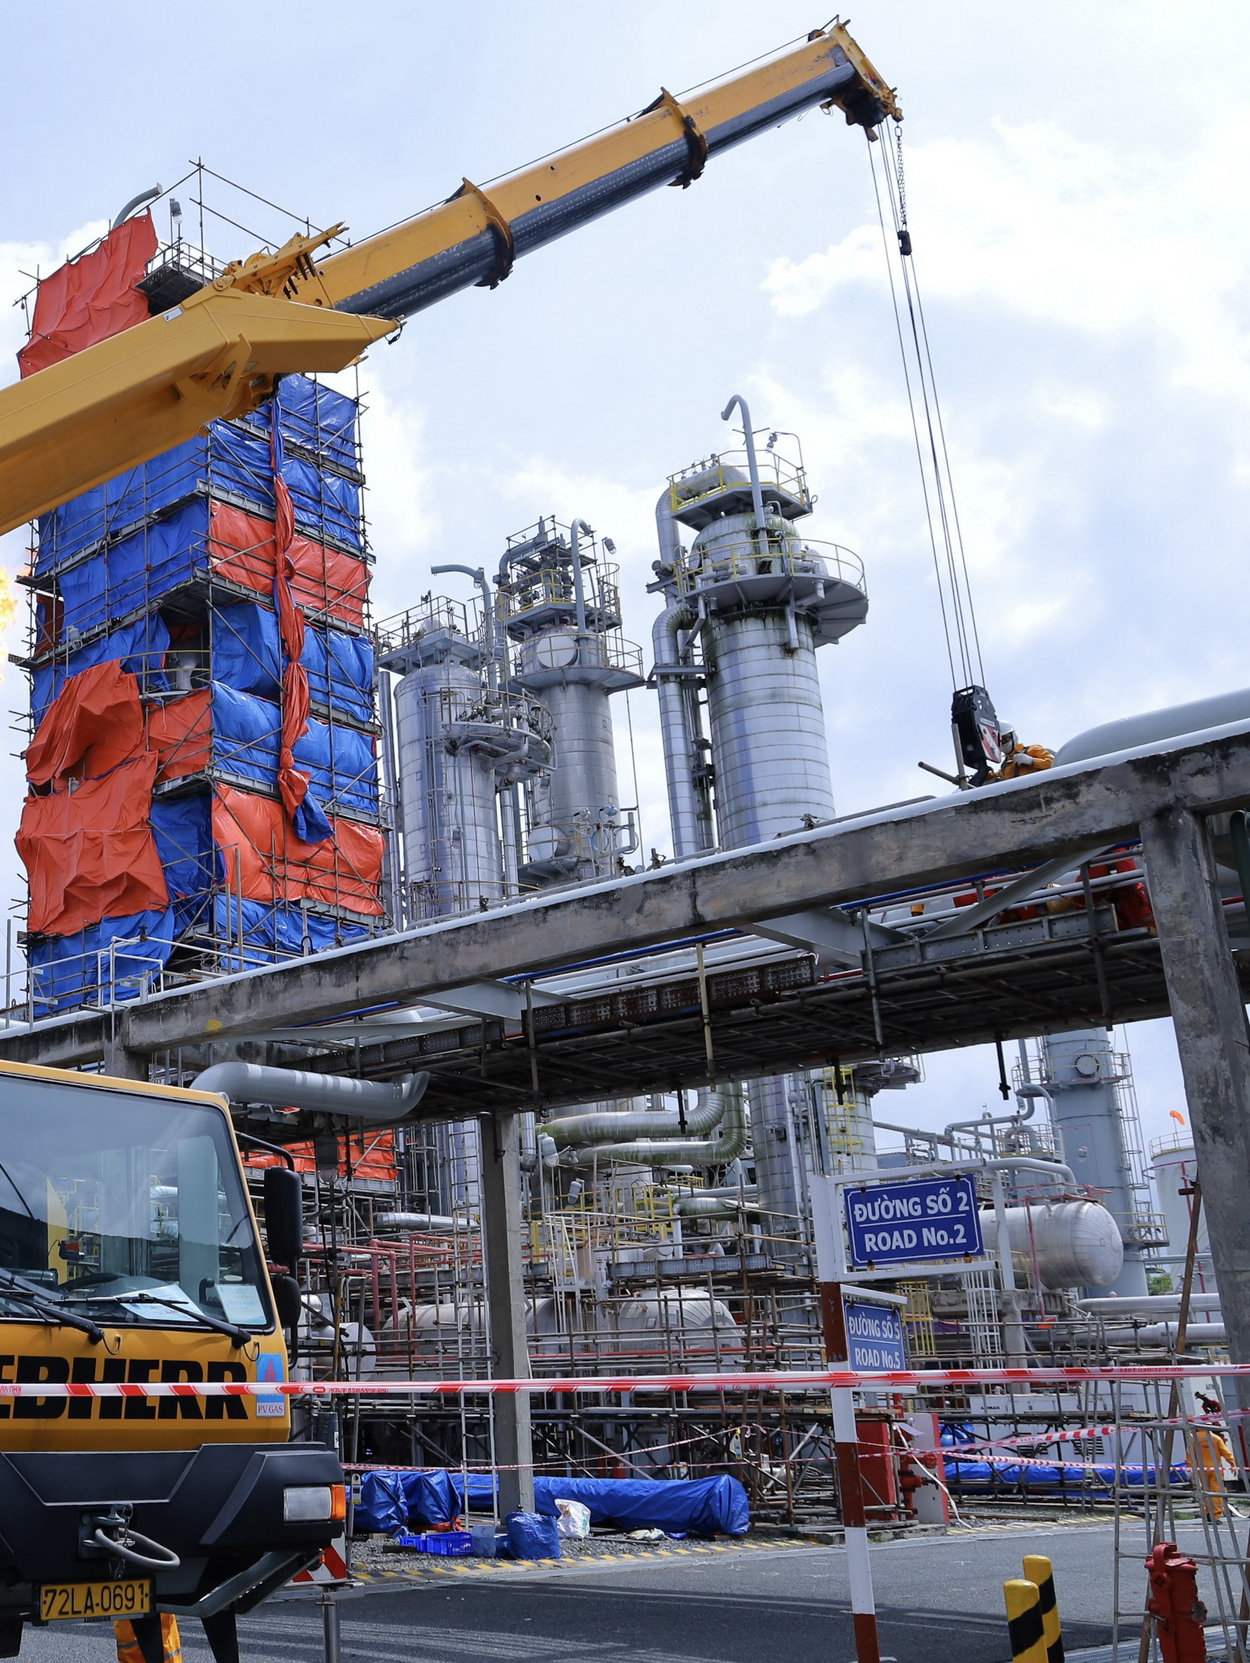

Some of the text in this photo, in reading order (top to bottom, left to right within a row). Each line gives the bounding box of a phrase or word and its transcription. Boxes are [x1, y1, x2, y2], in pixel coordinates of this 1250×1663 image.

[854, 1187, 970, 1222] ĐƯỜNG SỐ 2
[864, 1224, 967, 1252] ROAD No.2
[849, 1312, 901, 1340] ĐƯỜNG SỐ 5
[855, 1347, 901, 1370] ROAD No.5
[258, 1405, 283, 1414] PV GAS
[44, 1583, 145, 1617] 72LA-0691
